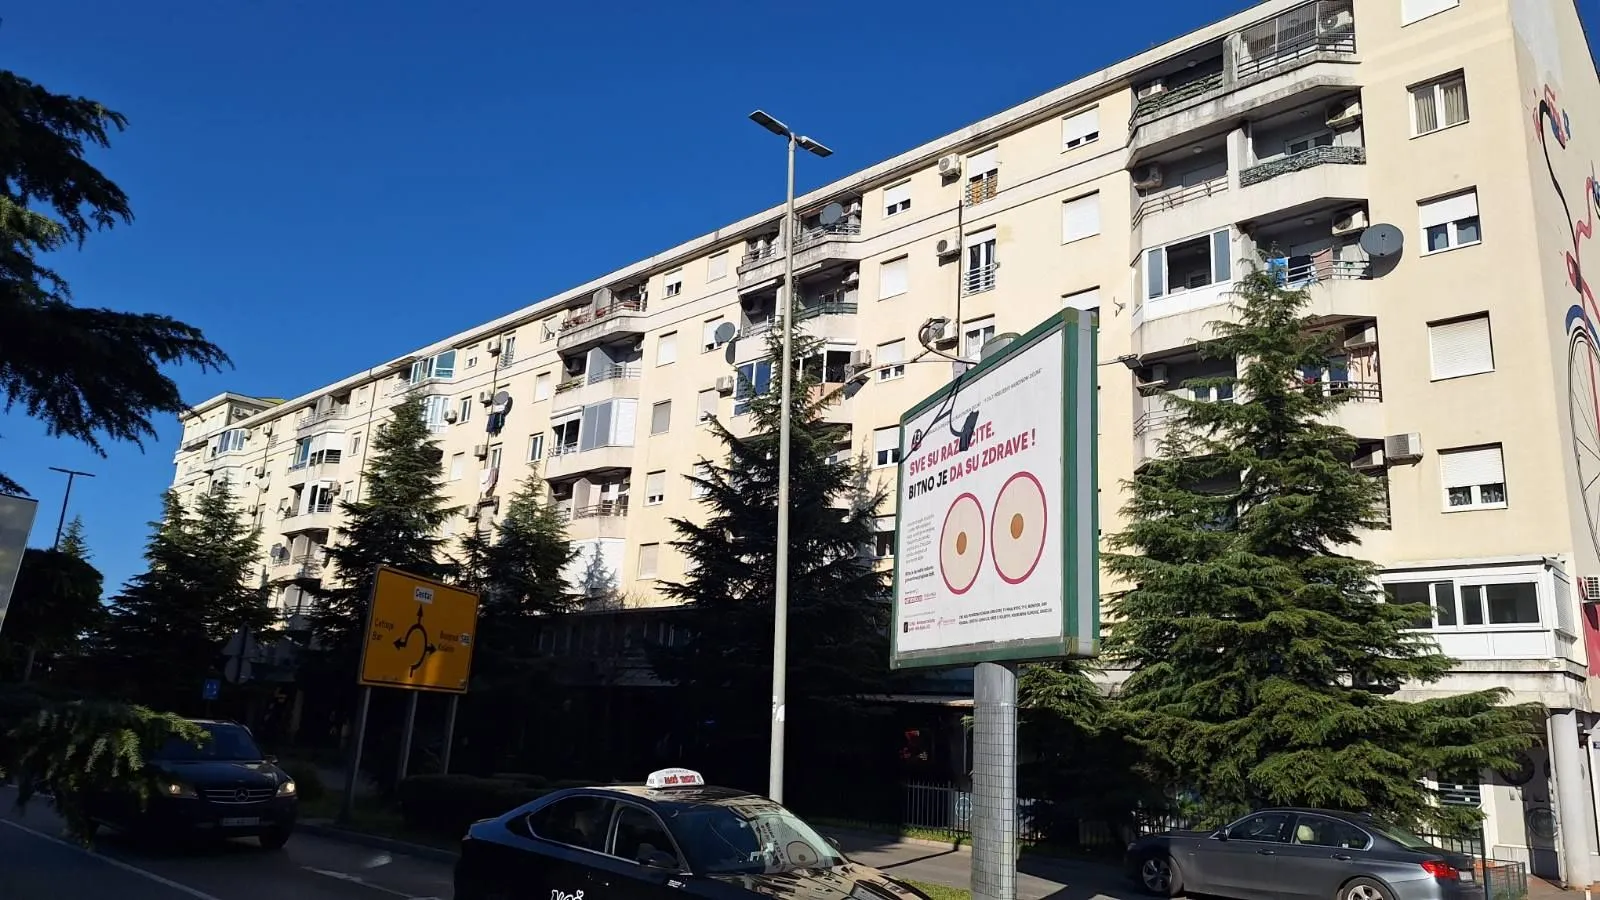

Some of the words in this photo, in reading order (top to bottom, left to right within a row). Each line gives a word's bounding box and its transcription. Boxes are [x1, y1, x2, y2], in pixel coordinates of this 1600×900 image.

[908, 476, 935, 500] BITNO
[936, 469, 948, 488] JE
[949, 462, 963, 482] DA
[965, 454, 979, 475] SU
[909, 456, 926, 476] SVE
[927, 449, 939, 467] SU
